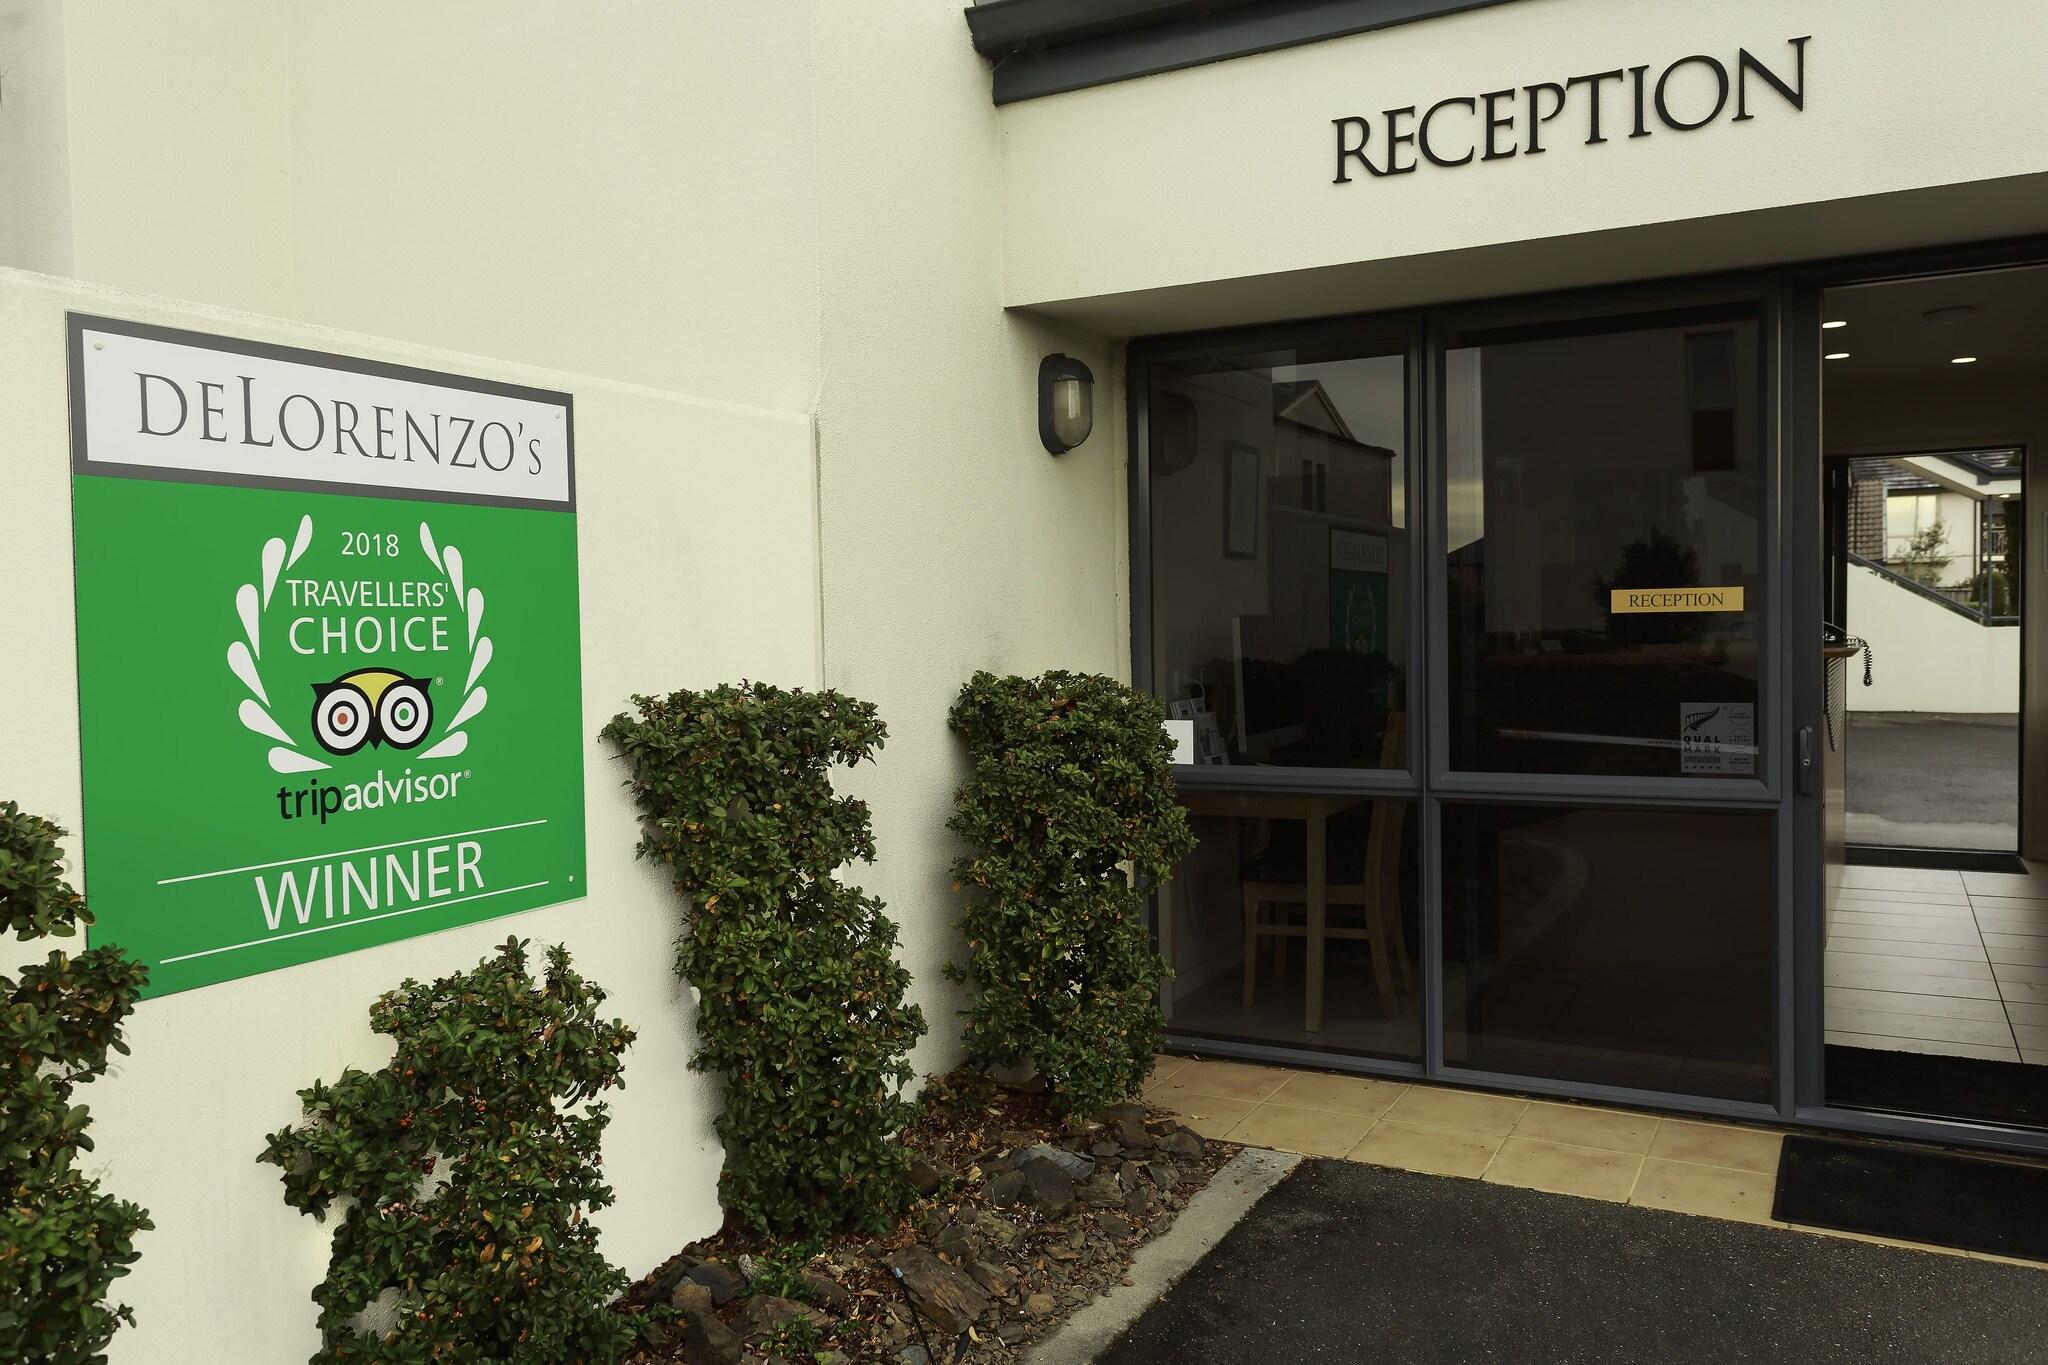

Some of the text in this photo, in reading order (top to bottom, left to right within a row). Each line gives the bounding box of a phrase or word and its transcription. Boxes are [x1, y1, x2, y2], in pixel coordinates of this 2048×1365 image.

[1331, 36, 1811, 184] RECEPTION
[340, 531, 400, 557] 2018
[286, 579, 449, 607] TRAVELLERS'
[1629, 592, 1724, 607] RECEPTION
[288, 616, 449, 654] CHOICE
[1683, 735, 1721, 745] QUAL
[1683, 746, 1721, 754] MARK
[255, 841, 484, 929] WINNER
